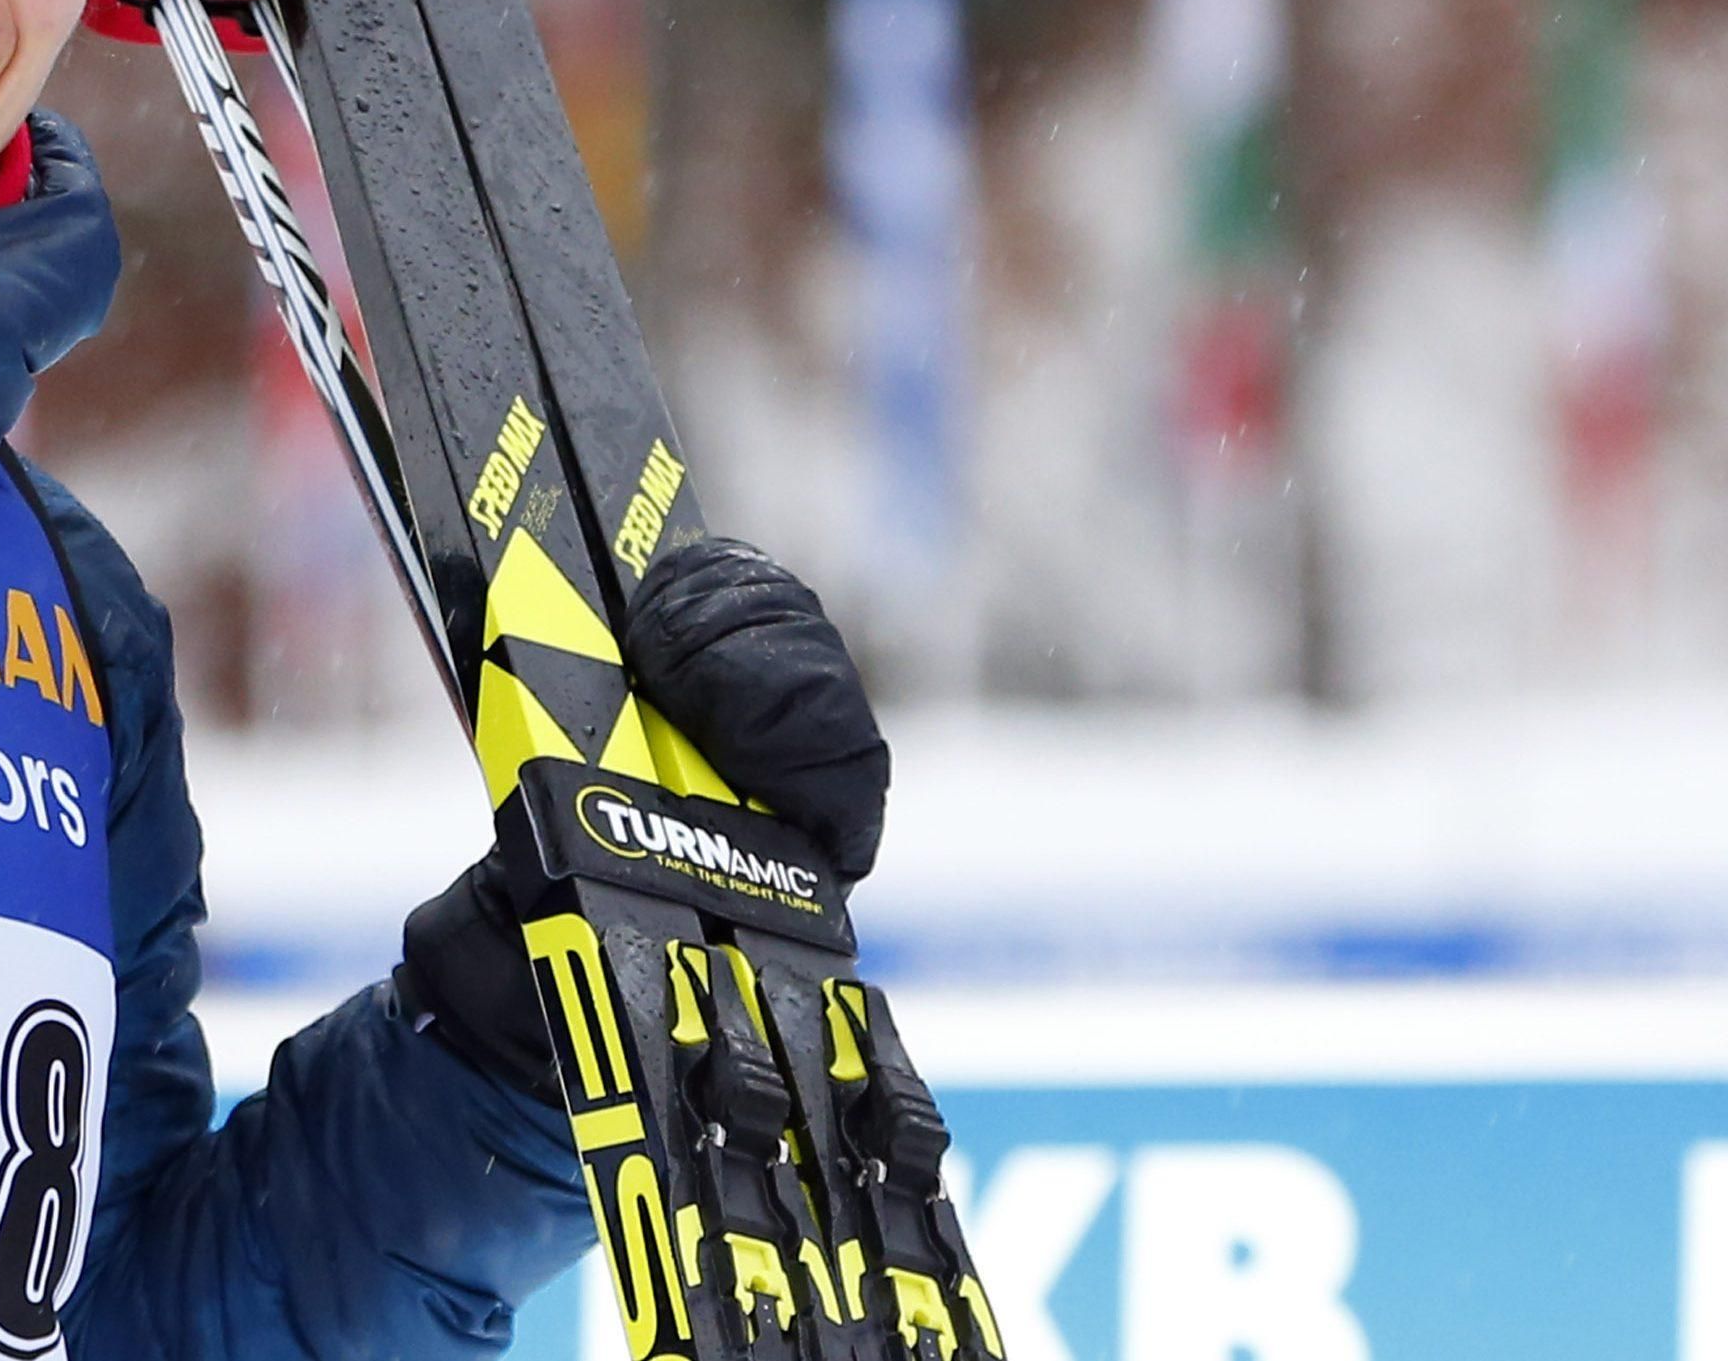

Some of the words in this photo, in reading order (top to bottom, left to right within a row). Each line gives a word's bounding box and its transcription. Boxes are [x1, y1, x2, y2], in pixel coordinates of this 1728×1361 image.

[655, 854, 694, 877] TAKE
[698, 869, 727, 889] THE
[728, 879, 775, 901] RIGHT
[522, 912, 696, 1361] FIS
